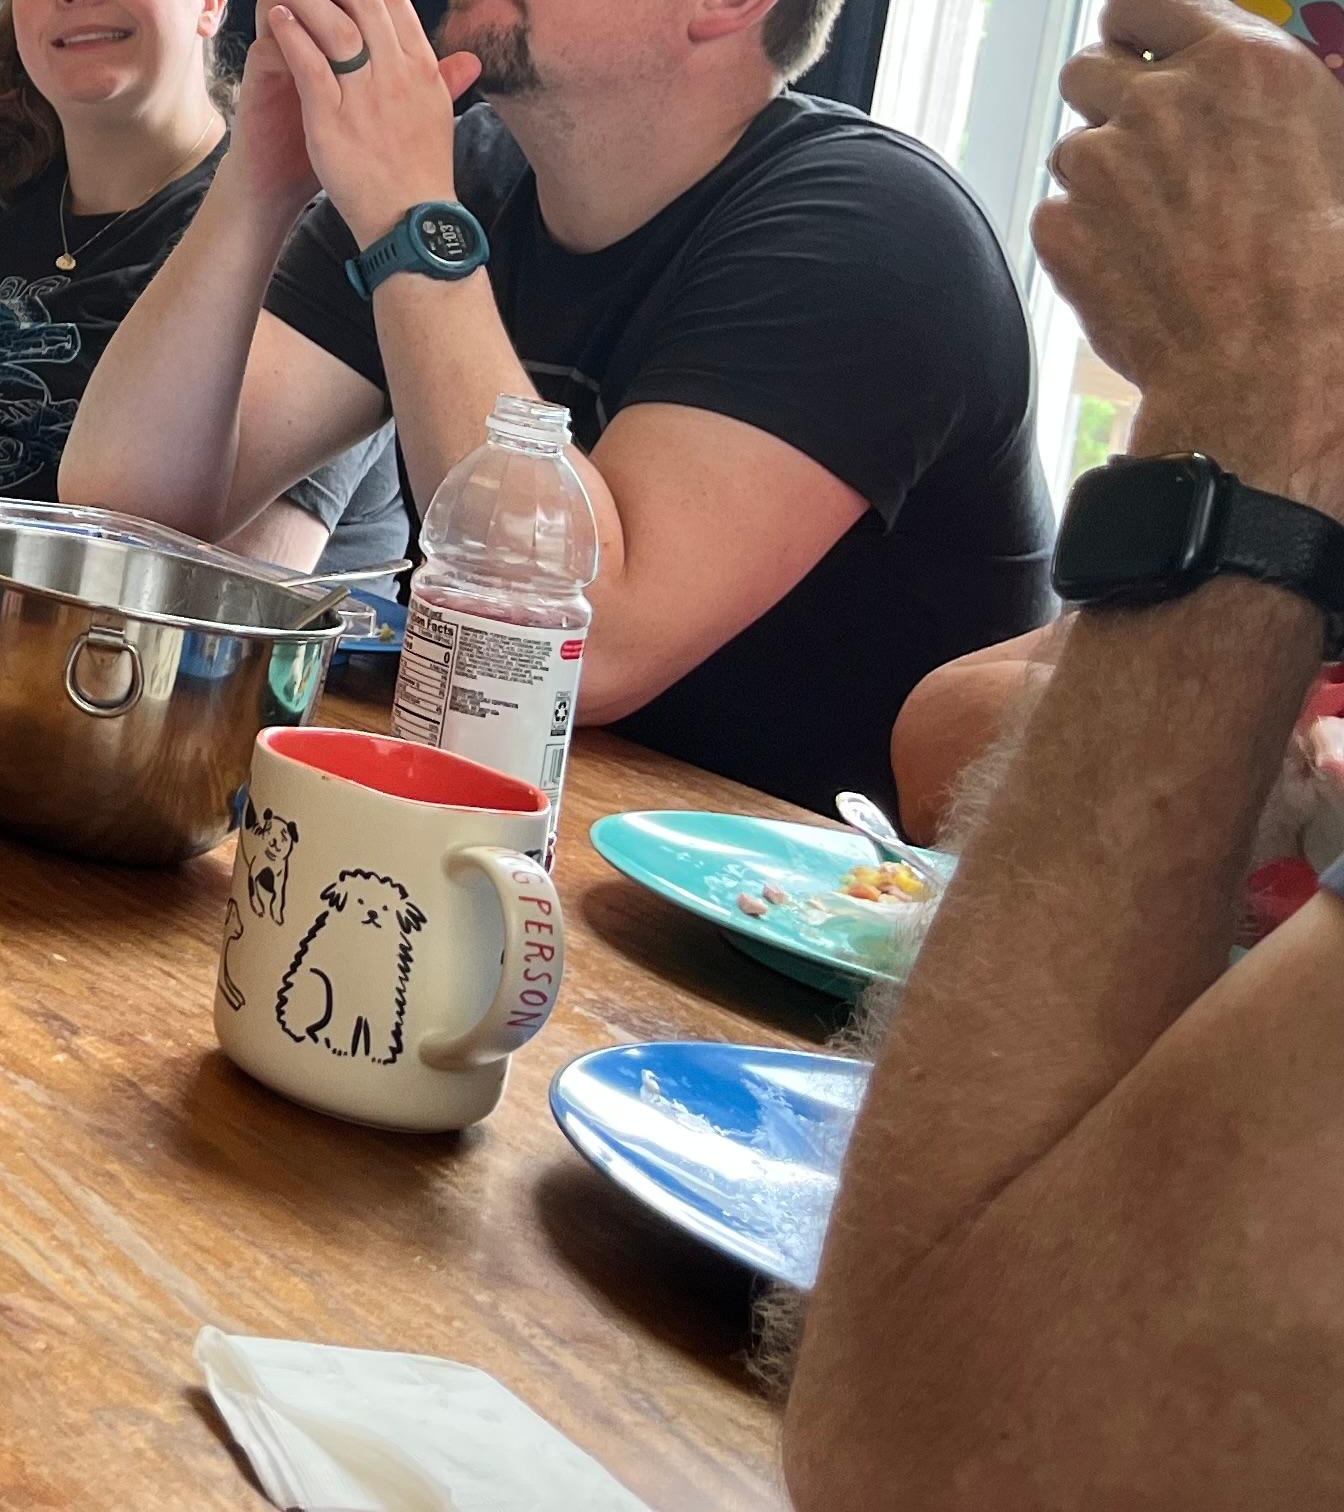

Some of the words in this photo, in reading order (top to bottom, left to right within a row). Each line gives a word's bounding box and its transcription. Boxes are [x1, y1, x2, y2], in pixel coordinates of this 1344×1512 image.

[440, 224, 463, 255] 11:03
[426, 618, 454, 637] Facts
[506, 894, 555, 1029] PERSON
